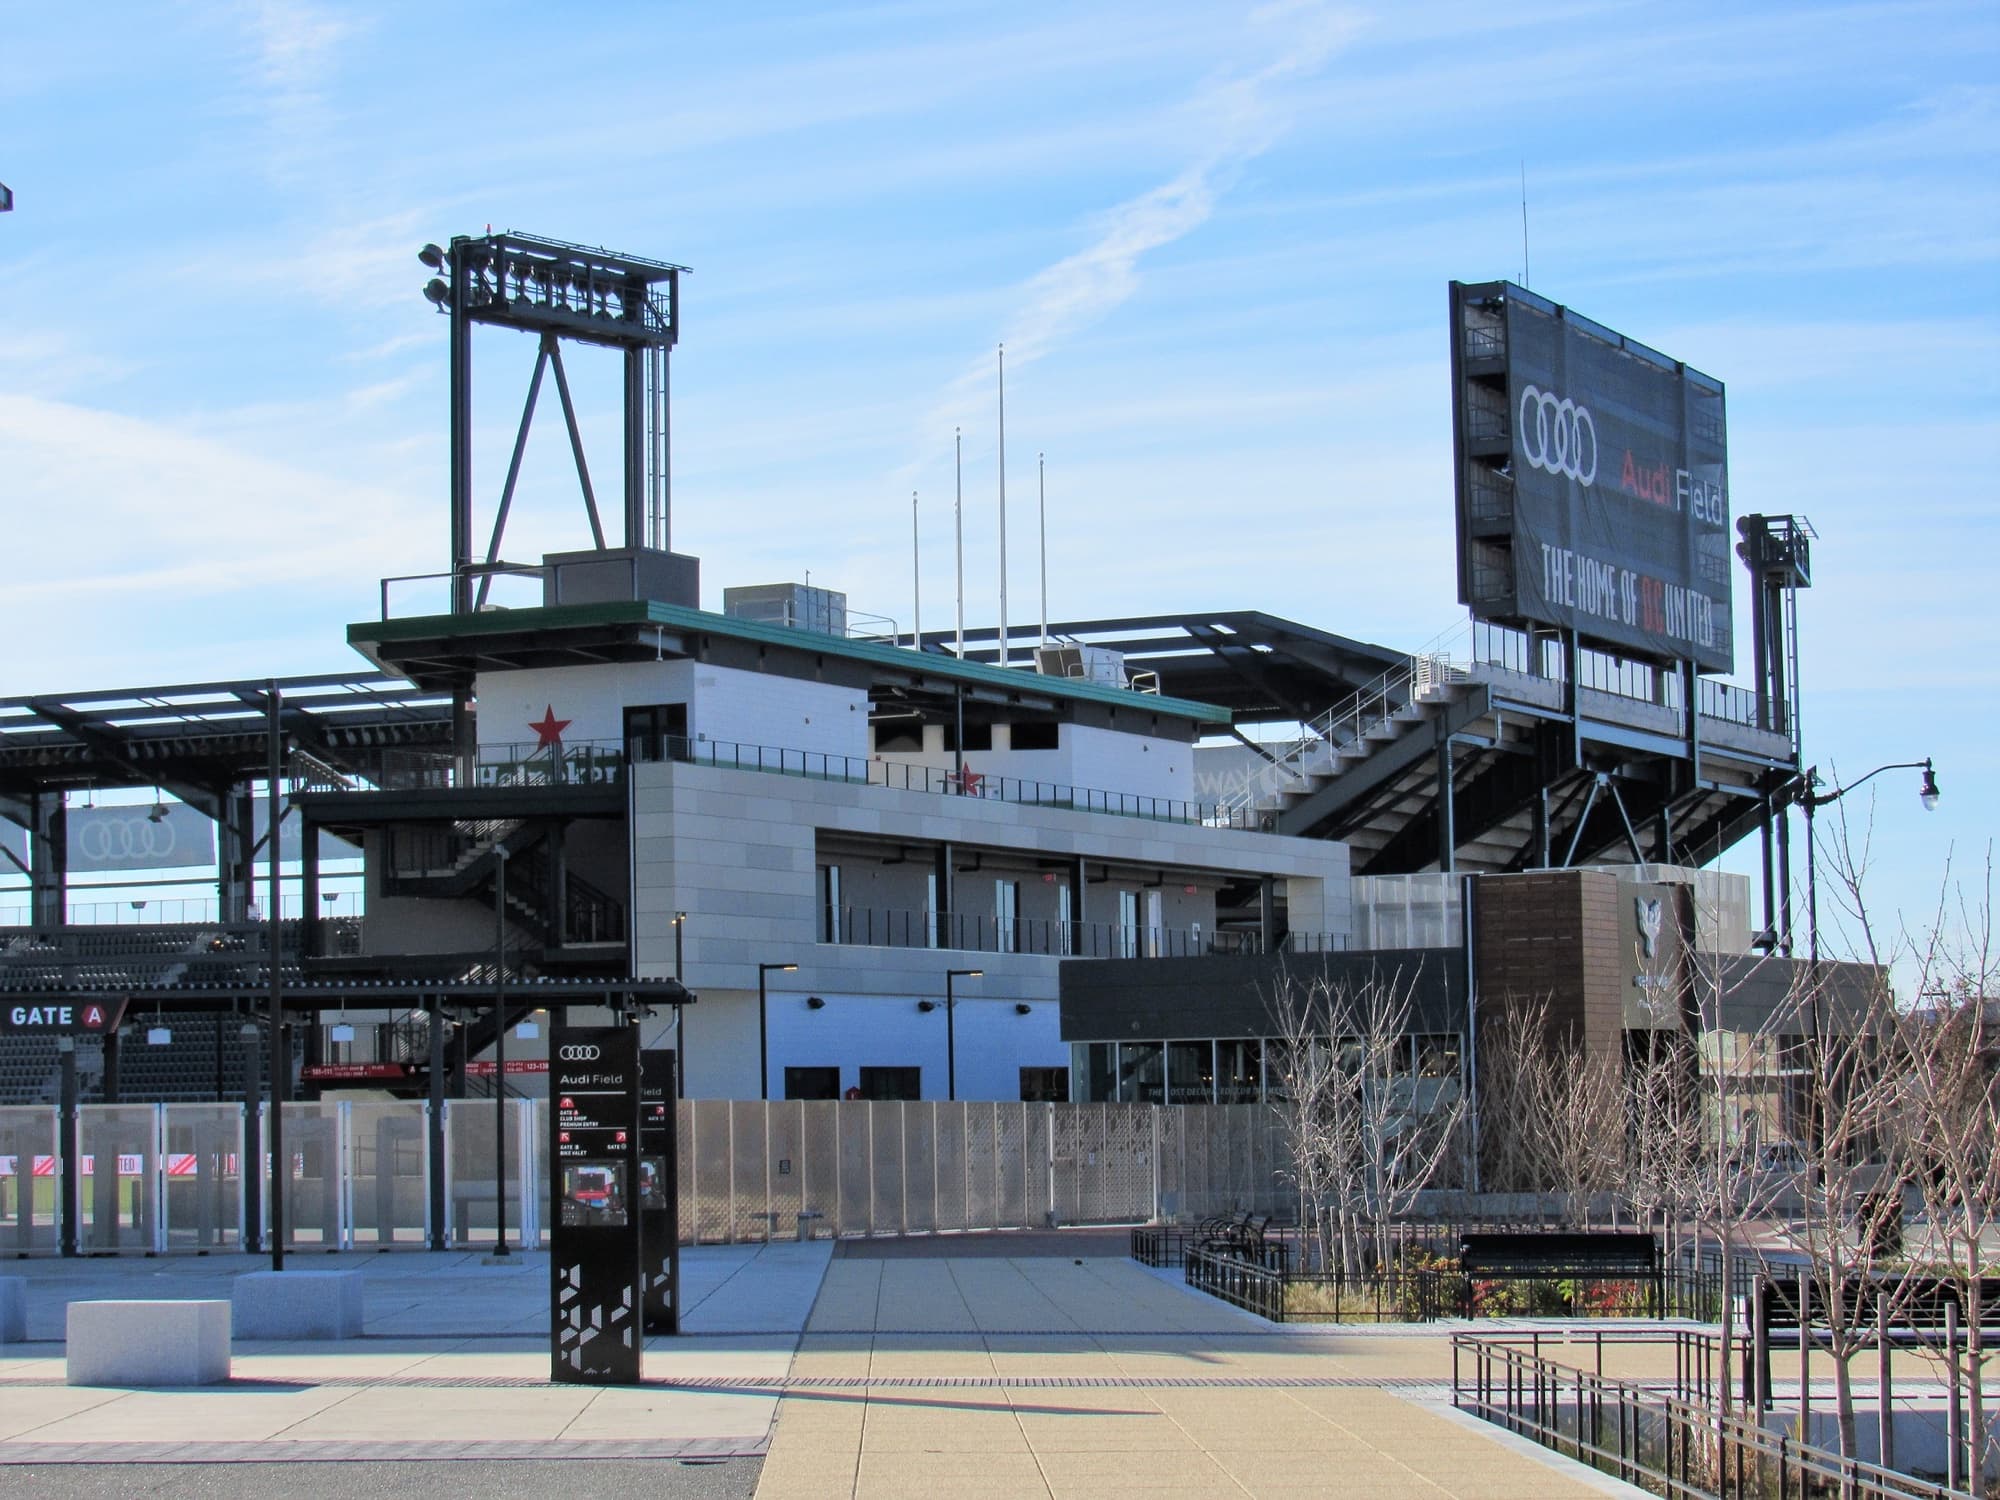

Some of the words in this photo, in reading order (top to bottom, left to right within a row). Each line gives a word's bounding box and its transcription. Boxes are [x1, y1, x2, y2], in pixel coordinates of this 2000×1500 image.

[1622, 448, 1672, 507] Audi
[1676, 468, 1723, 526] Field
[1541, 543, 1574, 607] THE
[1577, 554, 1617, 621] HOME
[1620, 569, 1638, 626] OF
[1664, 583, 1713, 648] UNITED
[11, 1006, 73, 1025] GATE
[88, 1007, 102, 1024] A
[560, 1074, 590, 1084] Audi
[592, 1074, 623, 1084] Field
[1148, 1088, 1163, 1097] THE
[1187, 1086, 1229, 1096] DECORAED
